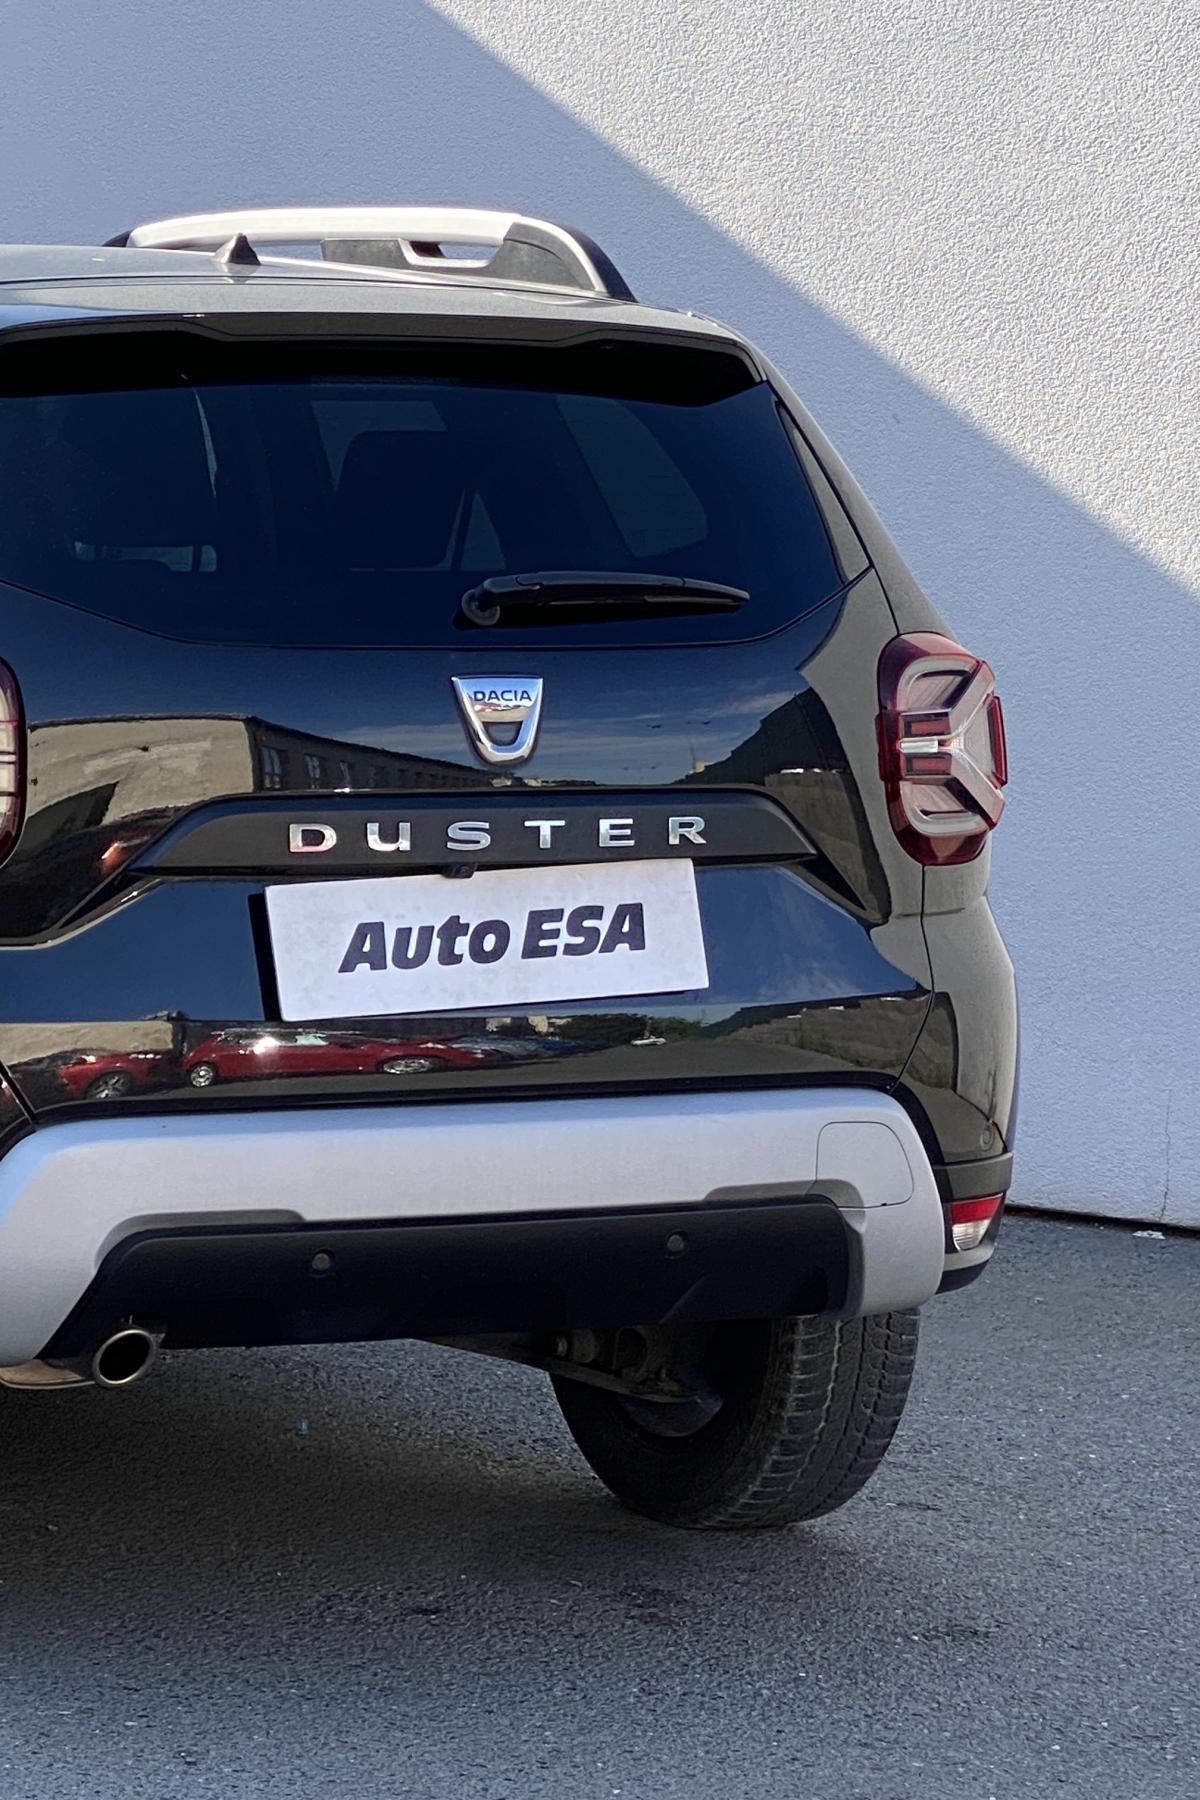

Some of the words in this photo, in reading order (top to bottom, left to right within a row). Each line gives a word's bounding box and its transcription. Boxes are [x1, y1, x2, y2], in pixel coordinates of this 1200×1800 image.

[473, 690, 532, 702] DACIA
[289, 816, 707, 853] DUSTER
[338, 915, 511, 974] Auto
[521, 902, 646, 960] ESA
